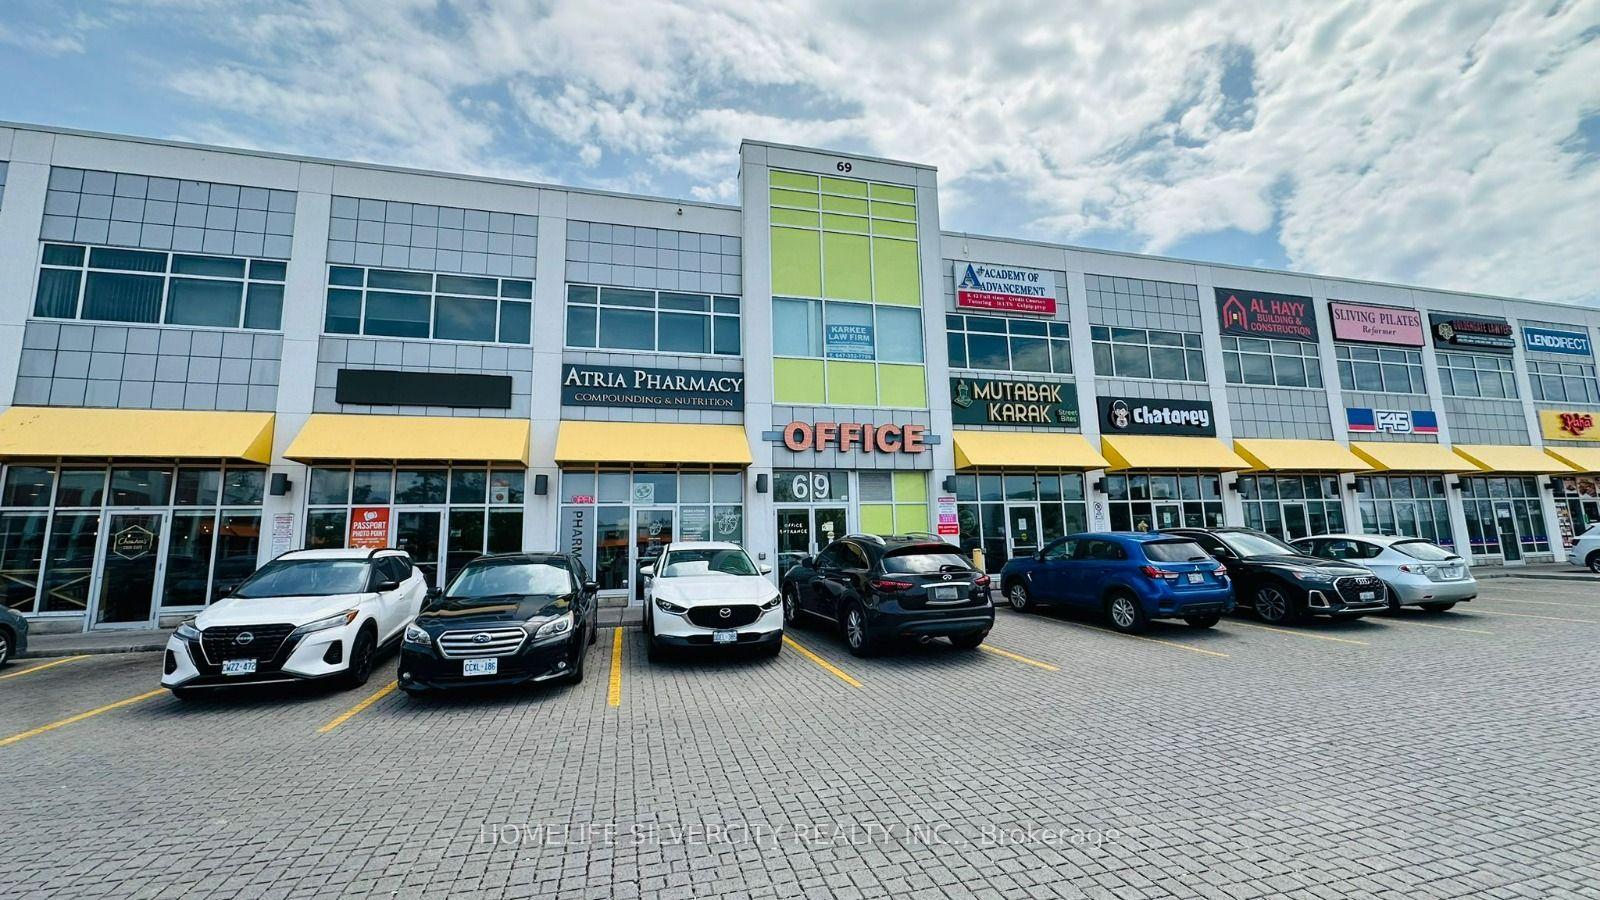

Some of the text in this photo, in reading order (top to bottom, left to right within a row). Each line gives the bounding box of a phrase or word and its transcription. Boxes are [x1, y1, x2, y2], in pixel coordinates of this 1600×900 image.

[837, 162, 852, 172] 69
[984, 268, 1040, 283] ACADEMY OF
[981, 281, 1045, 296] ADVANCEMENT
[1250, 298, 1306, 317] AL HAYY
[1257, 313, 1294, 325] BUILDING
[1334, 308, 1420, 327] SLIVING PILATES
[831, 326, 867, 334] KARKEE
[1250, 323, 1311, 336] CONSTRUCTION
[1362, 325, 1397, 336] Reformer
[1527, 333, 1587, 350] LENDDIRECT
[563, 366, 744, 393] ATRIA PHARMACY
[973, 381, 1063, 402] MUTABAK
[574, 393, 733, 407] COMPOUNDING & NUTRITION
[988, 402, 1051, 423] KARAK
[1375, 411, 1410, 432] F45
[783, 421, 926, 453] OFFICE
[792, 474, 830, 499] 69
[571, 495, 595, 504] OPEN
[353, 521, 386, 530] PASSPORT
